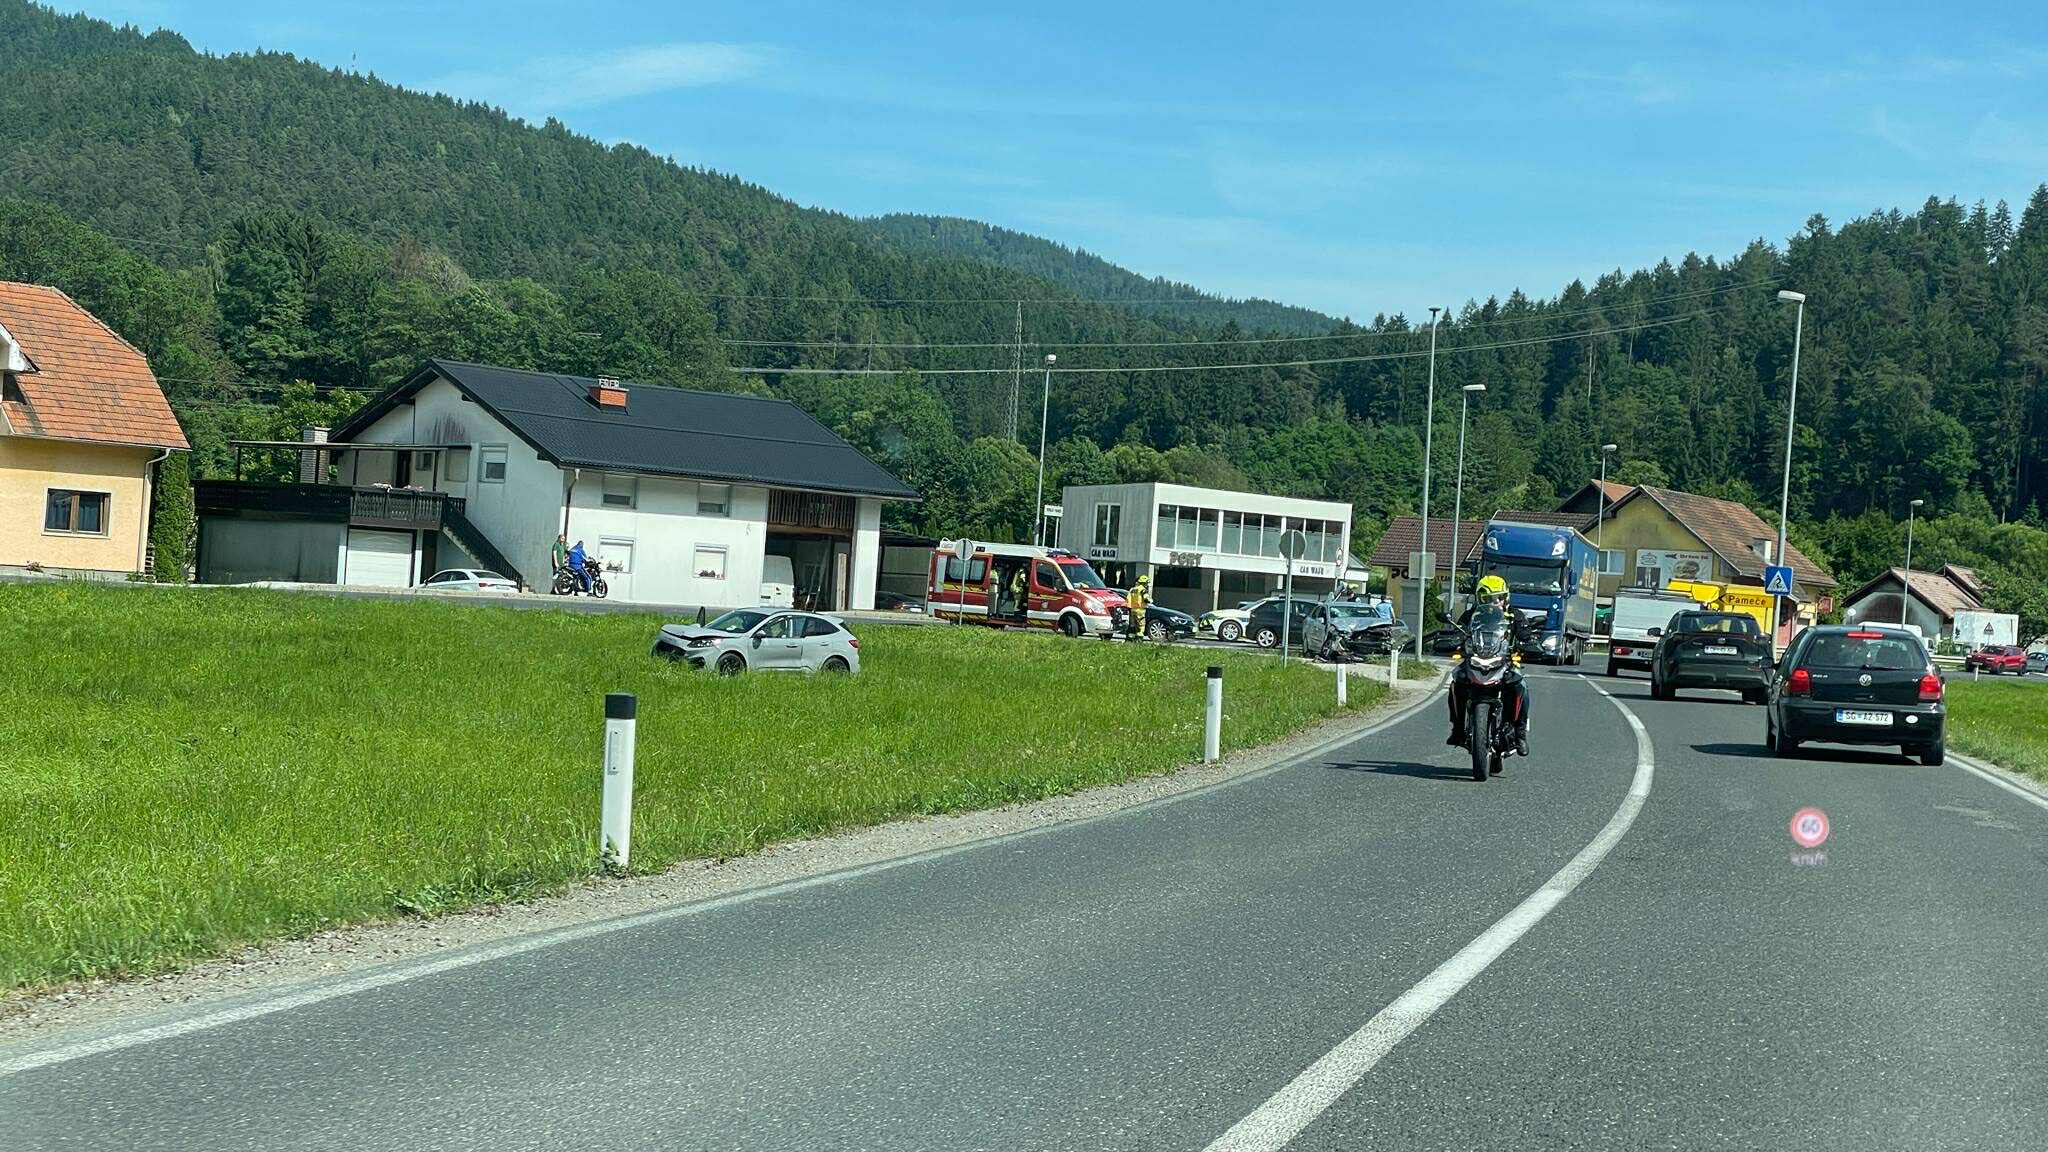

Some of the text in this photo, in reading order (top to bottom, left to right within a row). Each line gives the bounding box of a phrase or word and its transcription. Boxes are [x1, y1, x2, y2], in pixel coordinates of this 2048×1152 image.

[1091, 548, 1116, 557] CAR WASH
[1391, 568, 1410, 580] PO
